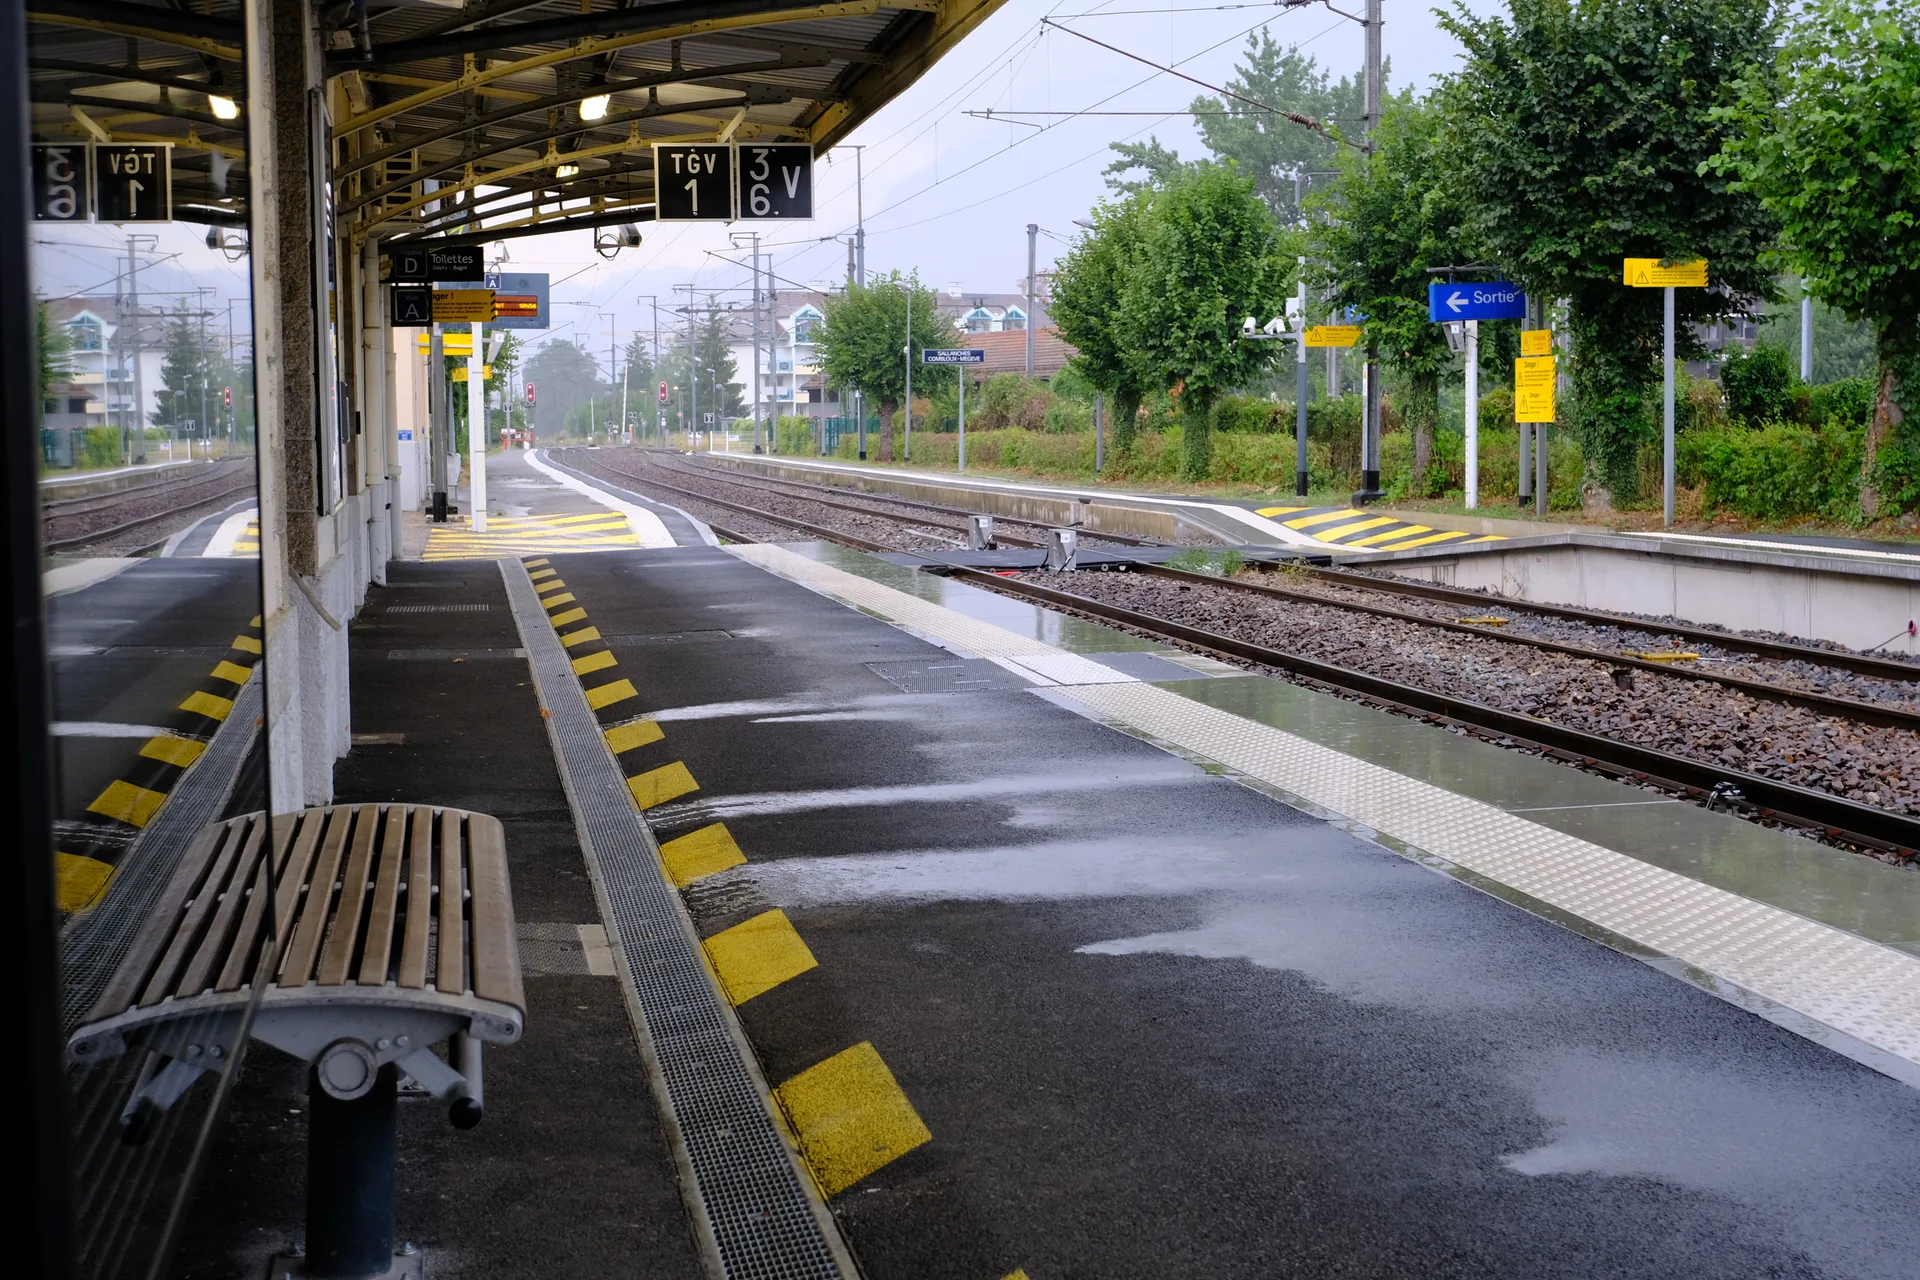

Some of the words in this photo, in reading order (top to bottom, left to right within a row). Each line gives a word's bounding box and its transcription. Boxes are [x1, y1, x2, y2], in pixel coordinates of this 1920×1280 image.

[670, 153, 717, 174] TGV
[749, 148, 770, 181] 3
[781, 165, 801, 199] V
[684, 178, 698, 212] 1
[749, 183, 771, 216] 6
[405, 258, 418, 273] D
[431, 253, 474, 264] Toilettes
[489, 279, 497, 288] A
[1473, 290, 1515, 304] Sortie
[405, 303, 420, 319] A
